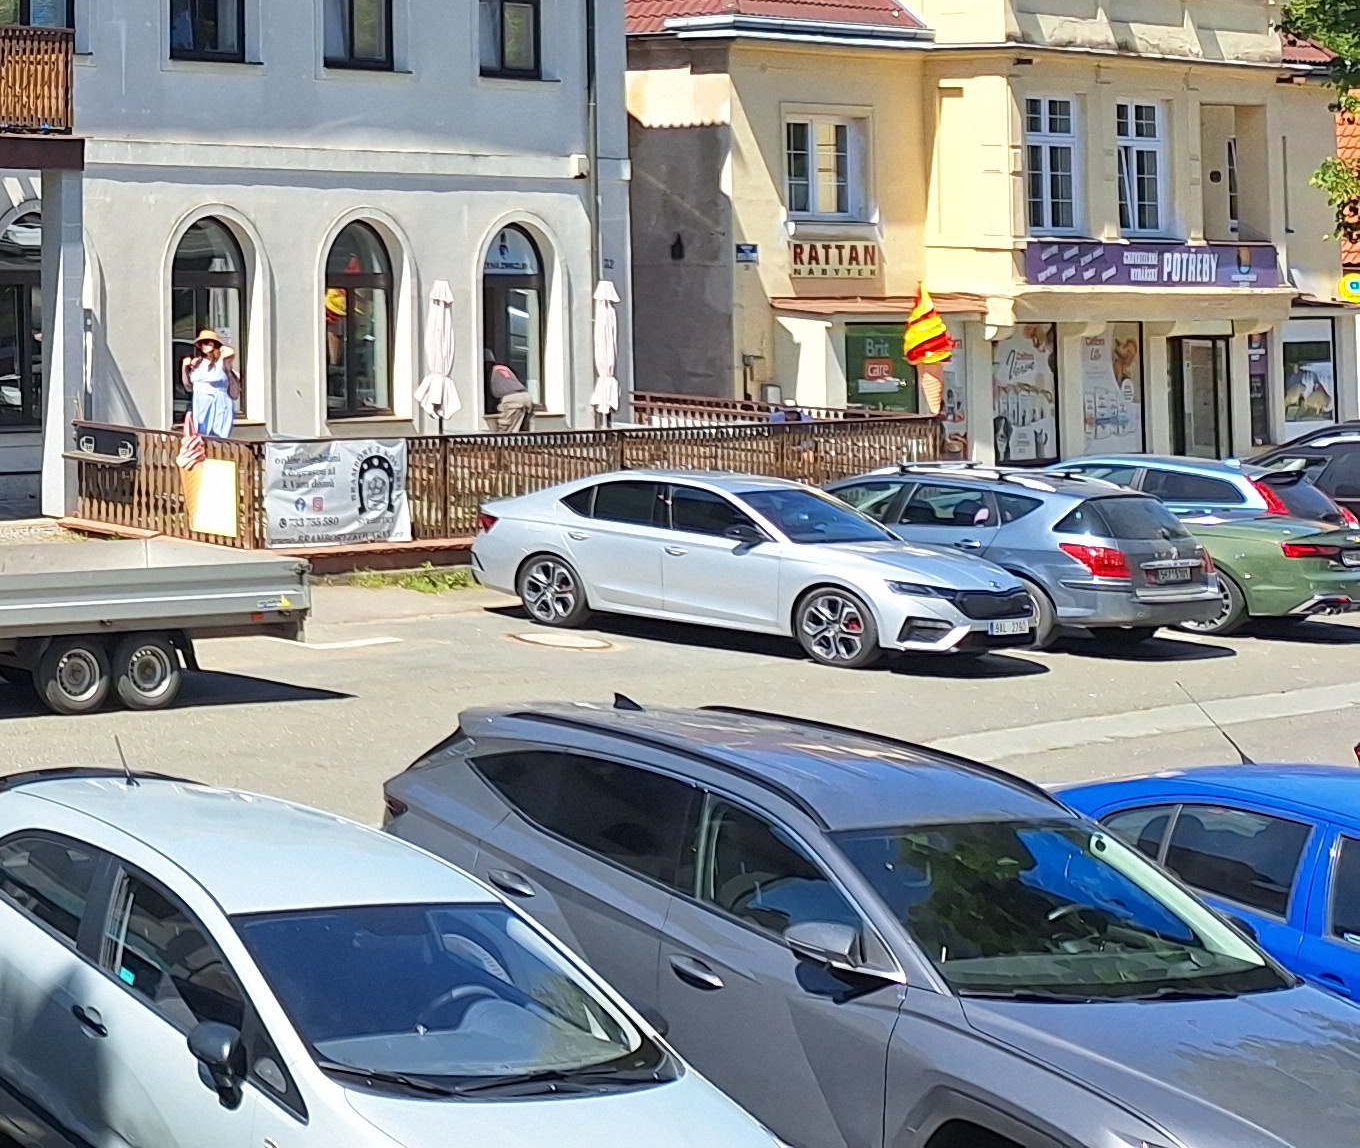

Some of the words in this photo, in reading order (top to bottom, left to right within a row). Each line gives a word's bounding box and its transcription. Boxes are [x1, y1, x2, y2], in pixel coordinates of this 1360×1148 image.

[793, 243, 877, 266] RATTAN
[793, 267, 877, 277] NÁBYTEK
[1162, 248, 1219, 283] POTŘEBY
[865, 338, 890, 357] Brit
[867, 363, 890, 377] care
